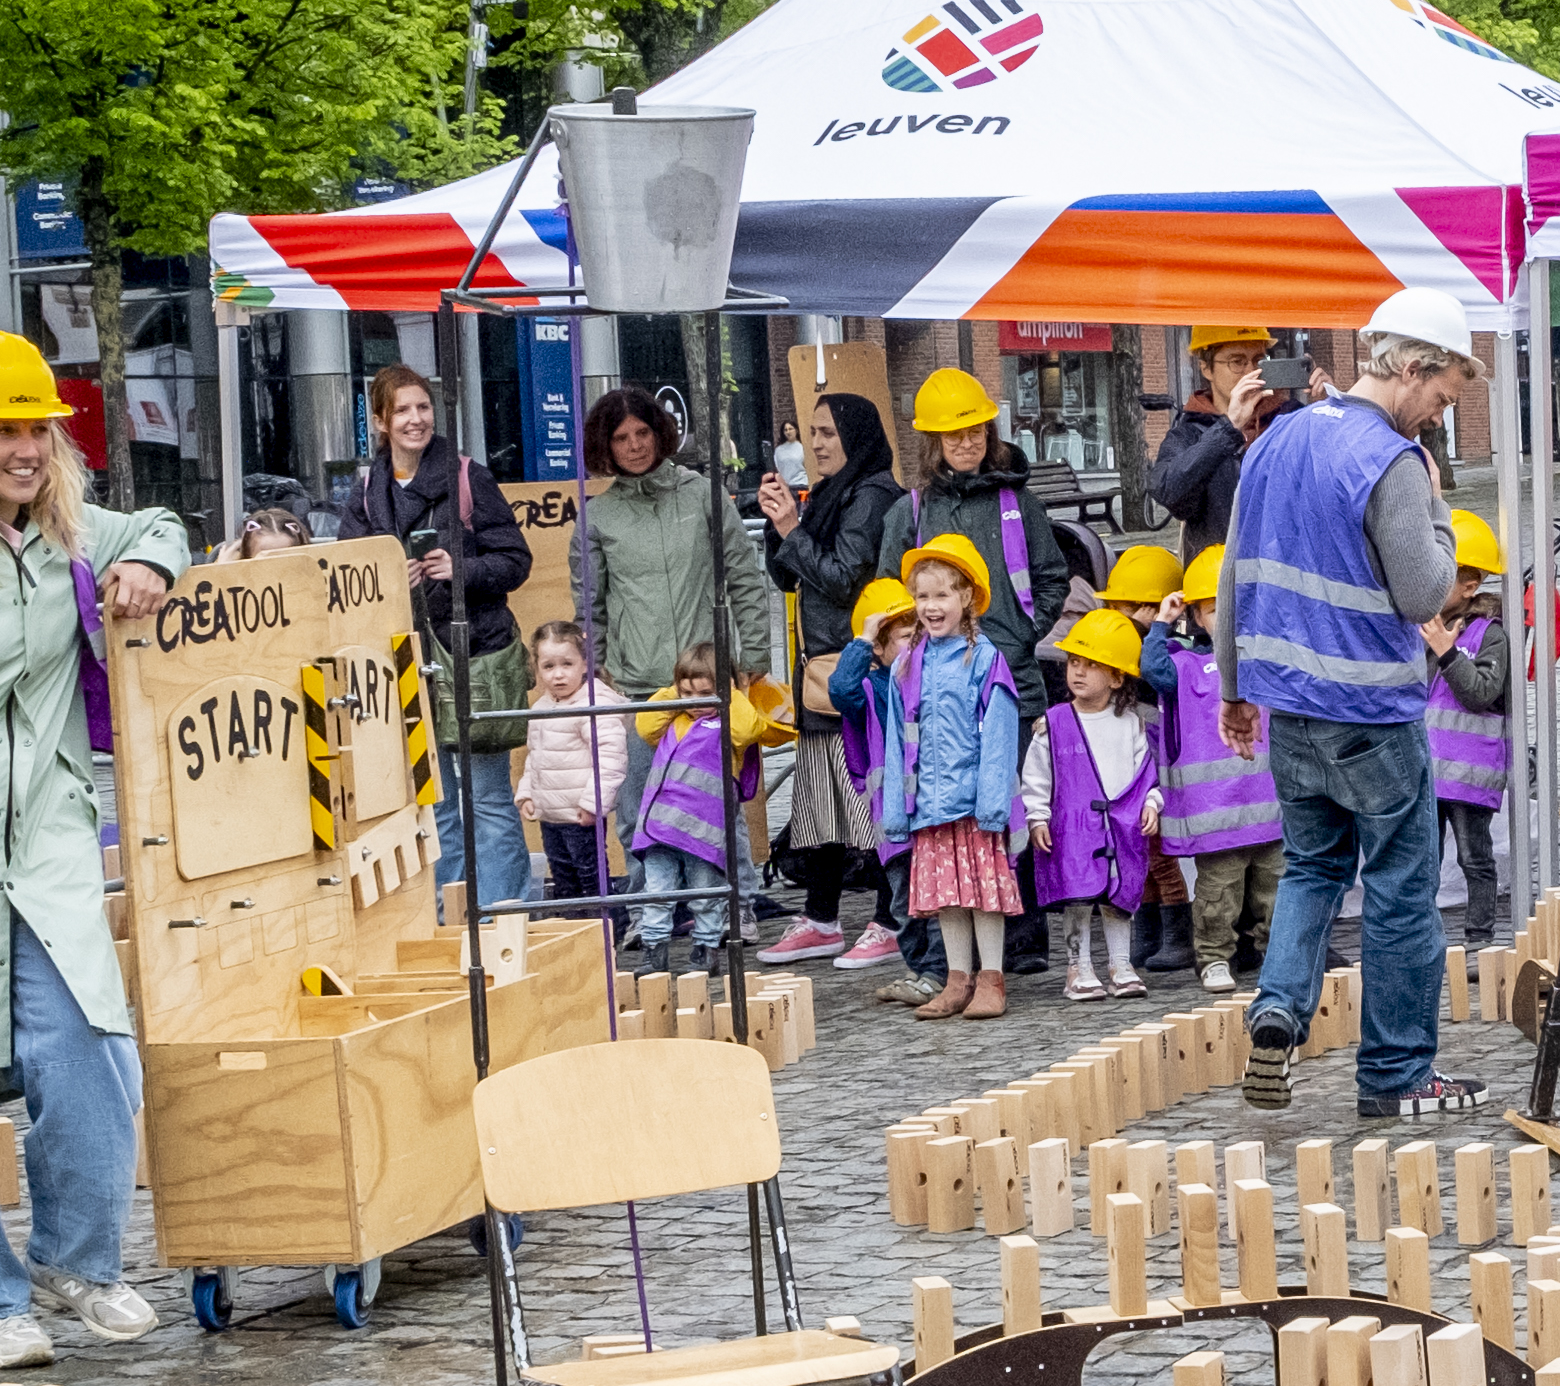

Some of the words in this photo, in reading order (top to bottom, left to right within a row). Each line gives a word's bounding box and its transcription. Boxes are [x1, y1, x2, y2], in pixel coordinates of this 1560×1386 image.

[813, 114, 1011, 146] leuven
[535, 324, 569, 341] KBC
[317, 559, 384, 614] ATOOL
[156, 581, 290, 653] CREATOOL
[350, 659, 393, 725] ART
[178, 689, 298, 781] START
